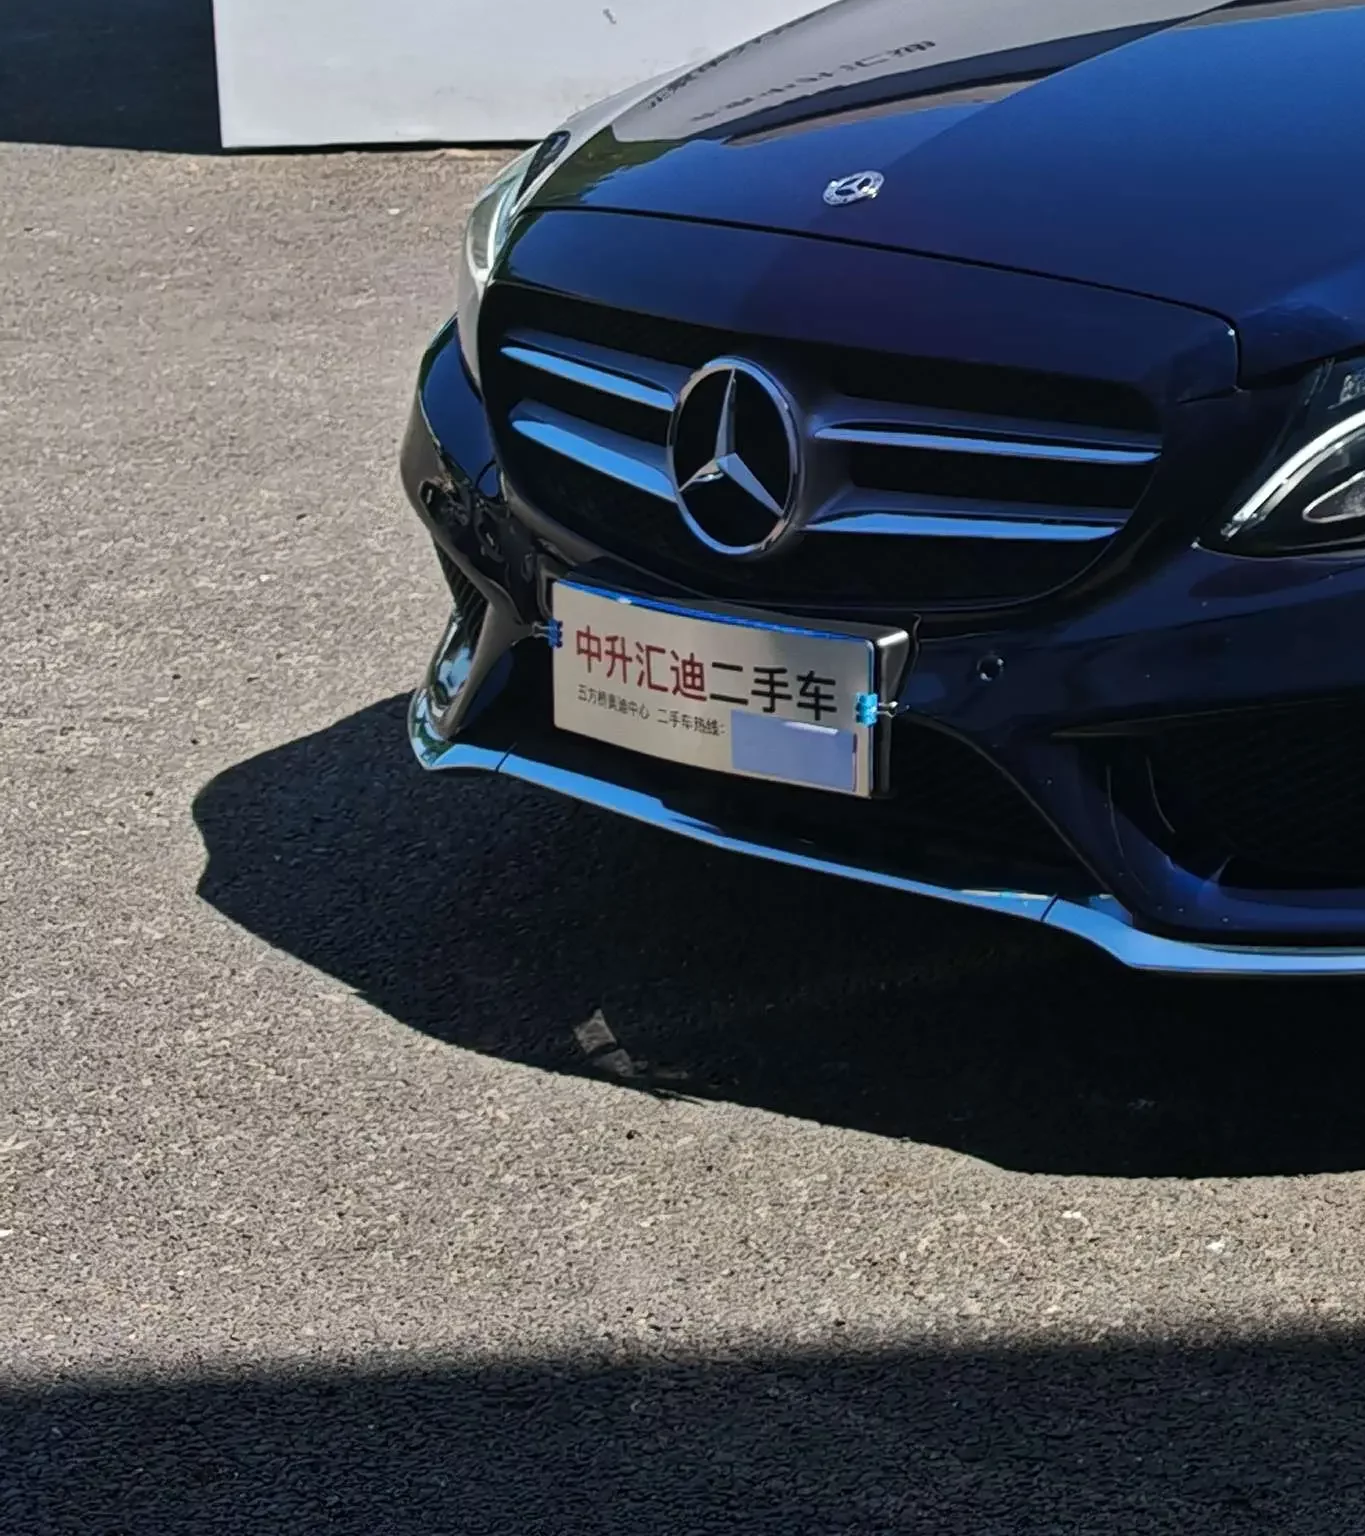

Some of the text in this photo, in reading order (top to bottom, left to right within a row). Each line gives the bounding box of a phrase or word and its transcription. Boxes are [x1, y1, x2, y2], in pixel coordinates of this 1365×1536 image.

[576, 624, 838, 721] 中升汇迪二手车
